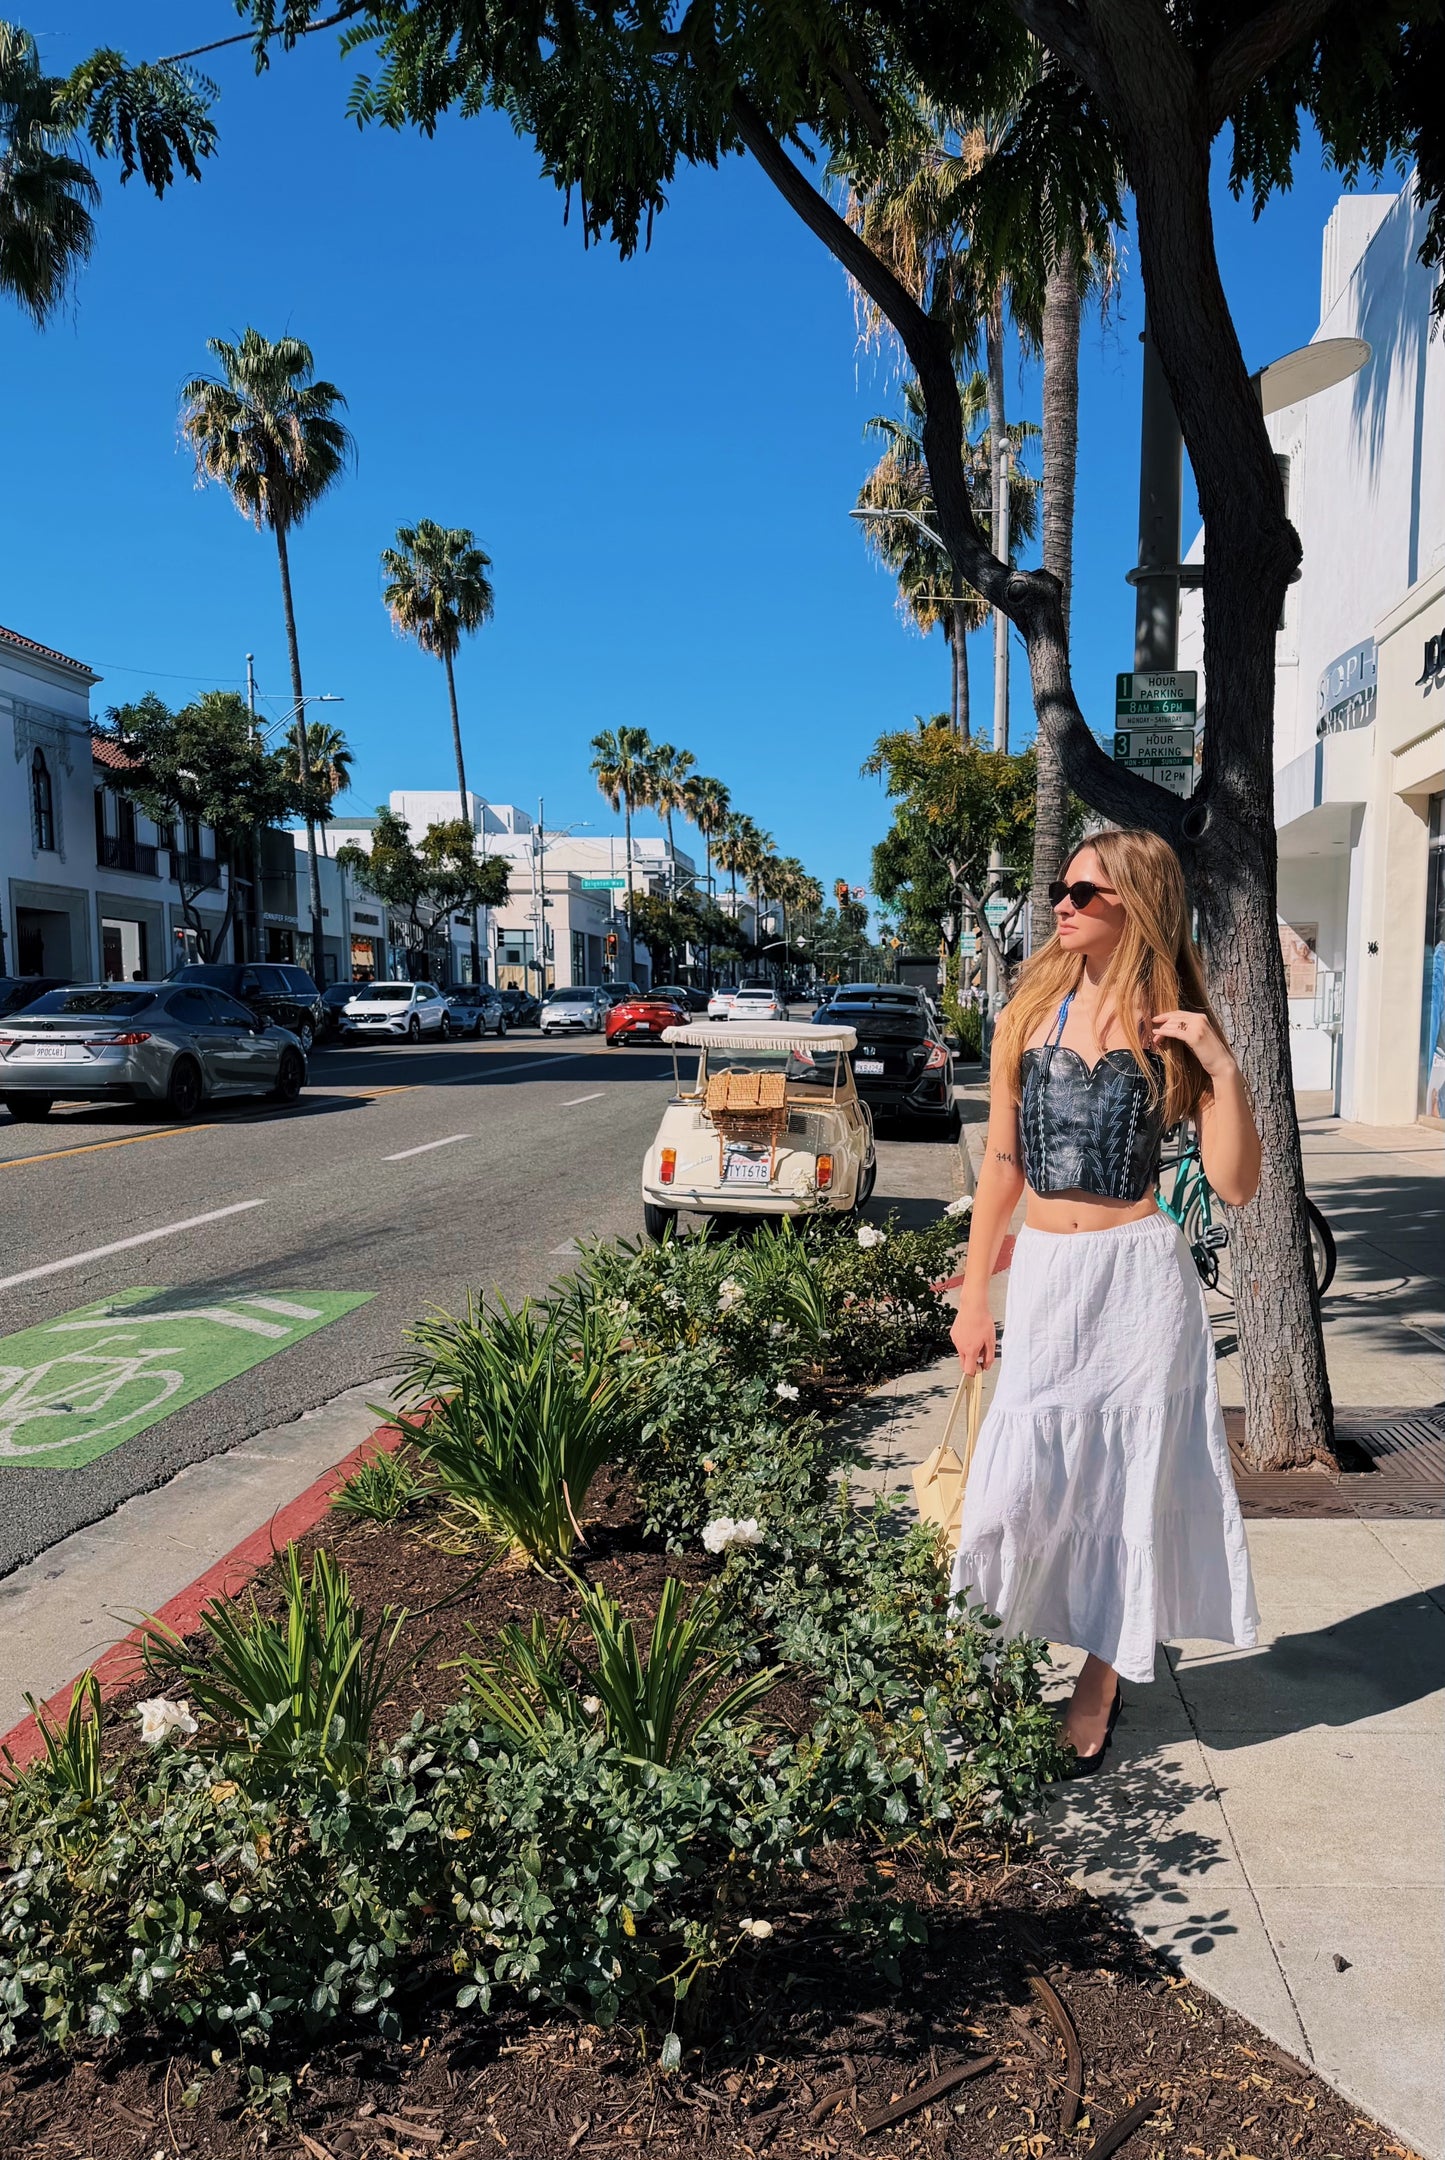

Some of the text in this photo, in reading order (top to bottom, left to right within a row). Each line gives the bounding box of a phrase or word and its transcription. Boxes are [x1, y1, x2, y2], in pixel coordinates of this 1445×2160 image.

[1122, 677, 1127, 697] 1
[1148, 677, 1176, 687] HOUR
[1140, 689, 1184, 699] PARKING
[1117, 735, 1128, 755] 3
[1146, 735, 1174, 745] HOUR
[1138, 747, 1182, 757] PARKING
[996, 1153, 1011, 1162] 444
